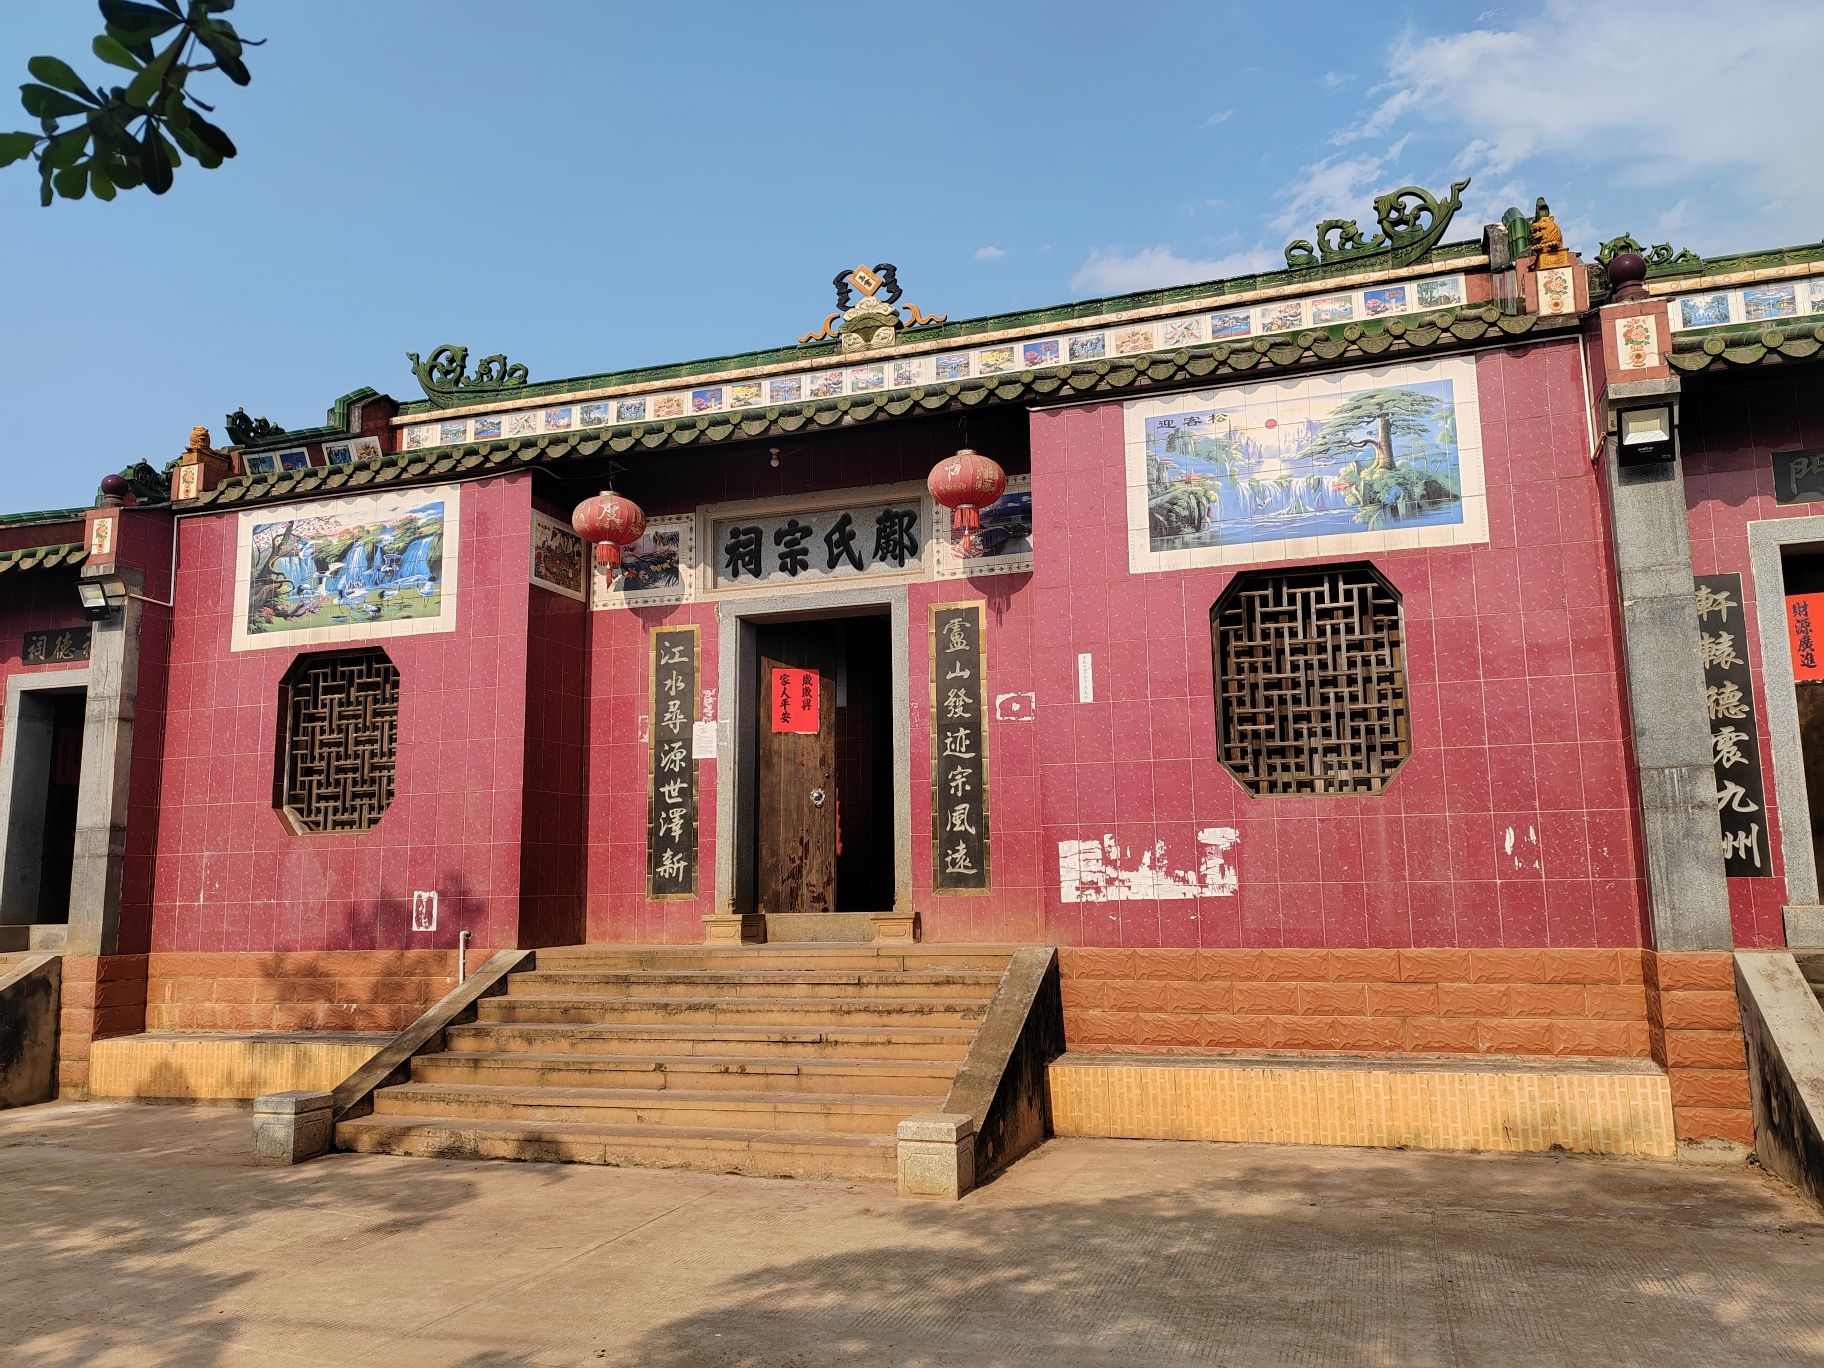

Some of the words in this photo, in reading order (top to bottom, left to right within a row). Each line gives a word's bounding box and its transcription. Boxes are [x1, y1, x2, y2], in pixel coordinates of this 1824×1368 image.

[1157, 413, 1228, 429] 迎客松
[724, 508, 918, 578] 鄺氏宗祠
[1792, 601, 1818, 668] 財源廣進
[779, 673, 791, 724] 家人平安
[655, 641, 689, 883] 江水尋源世澤新
